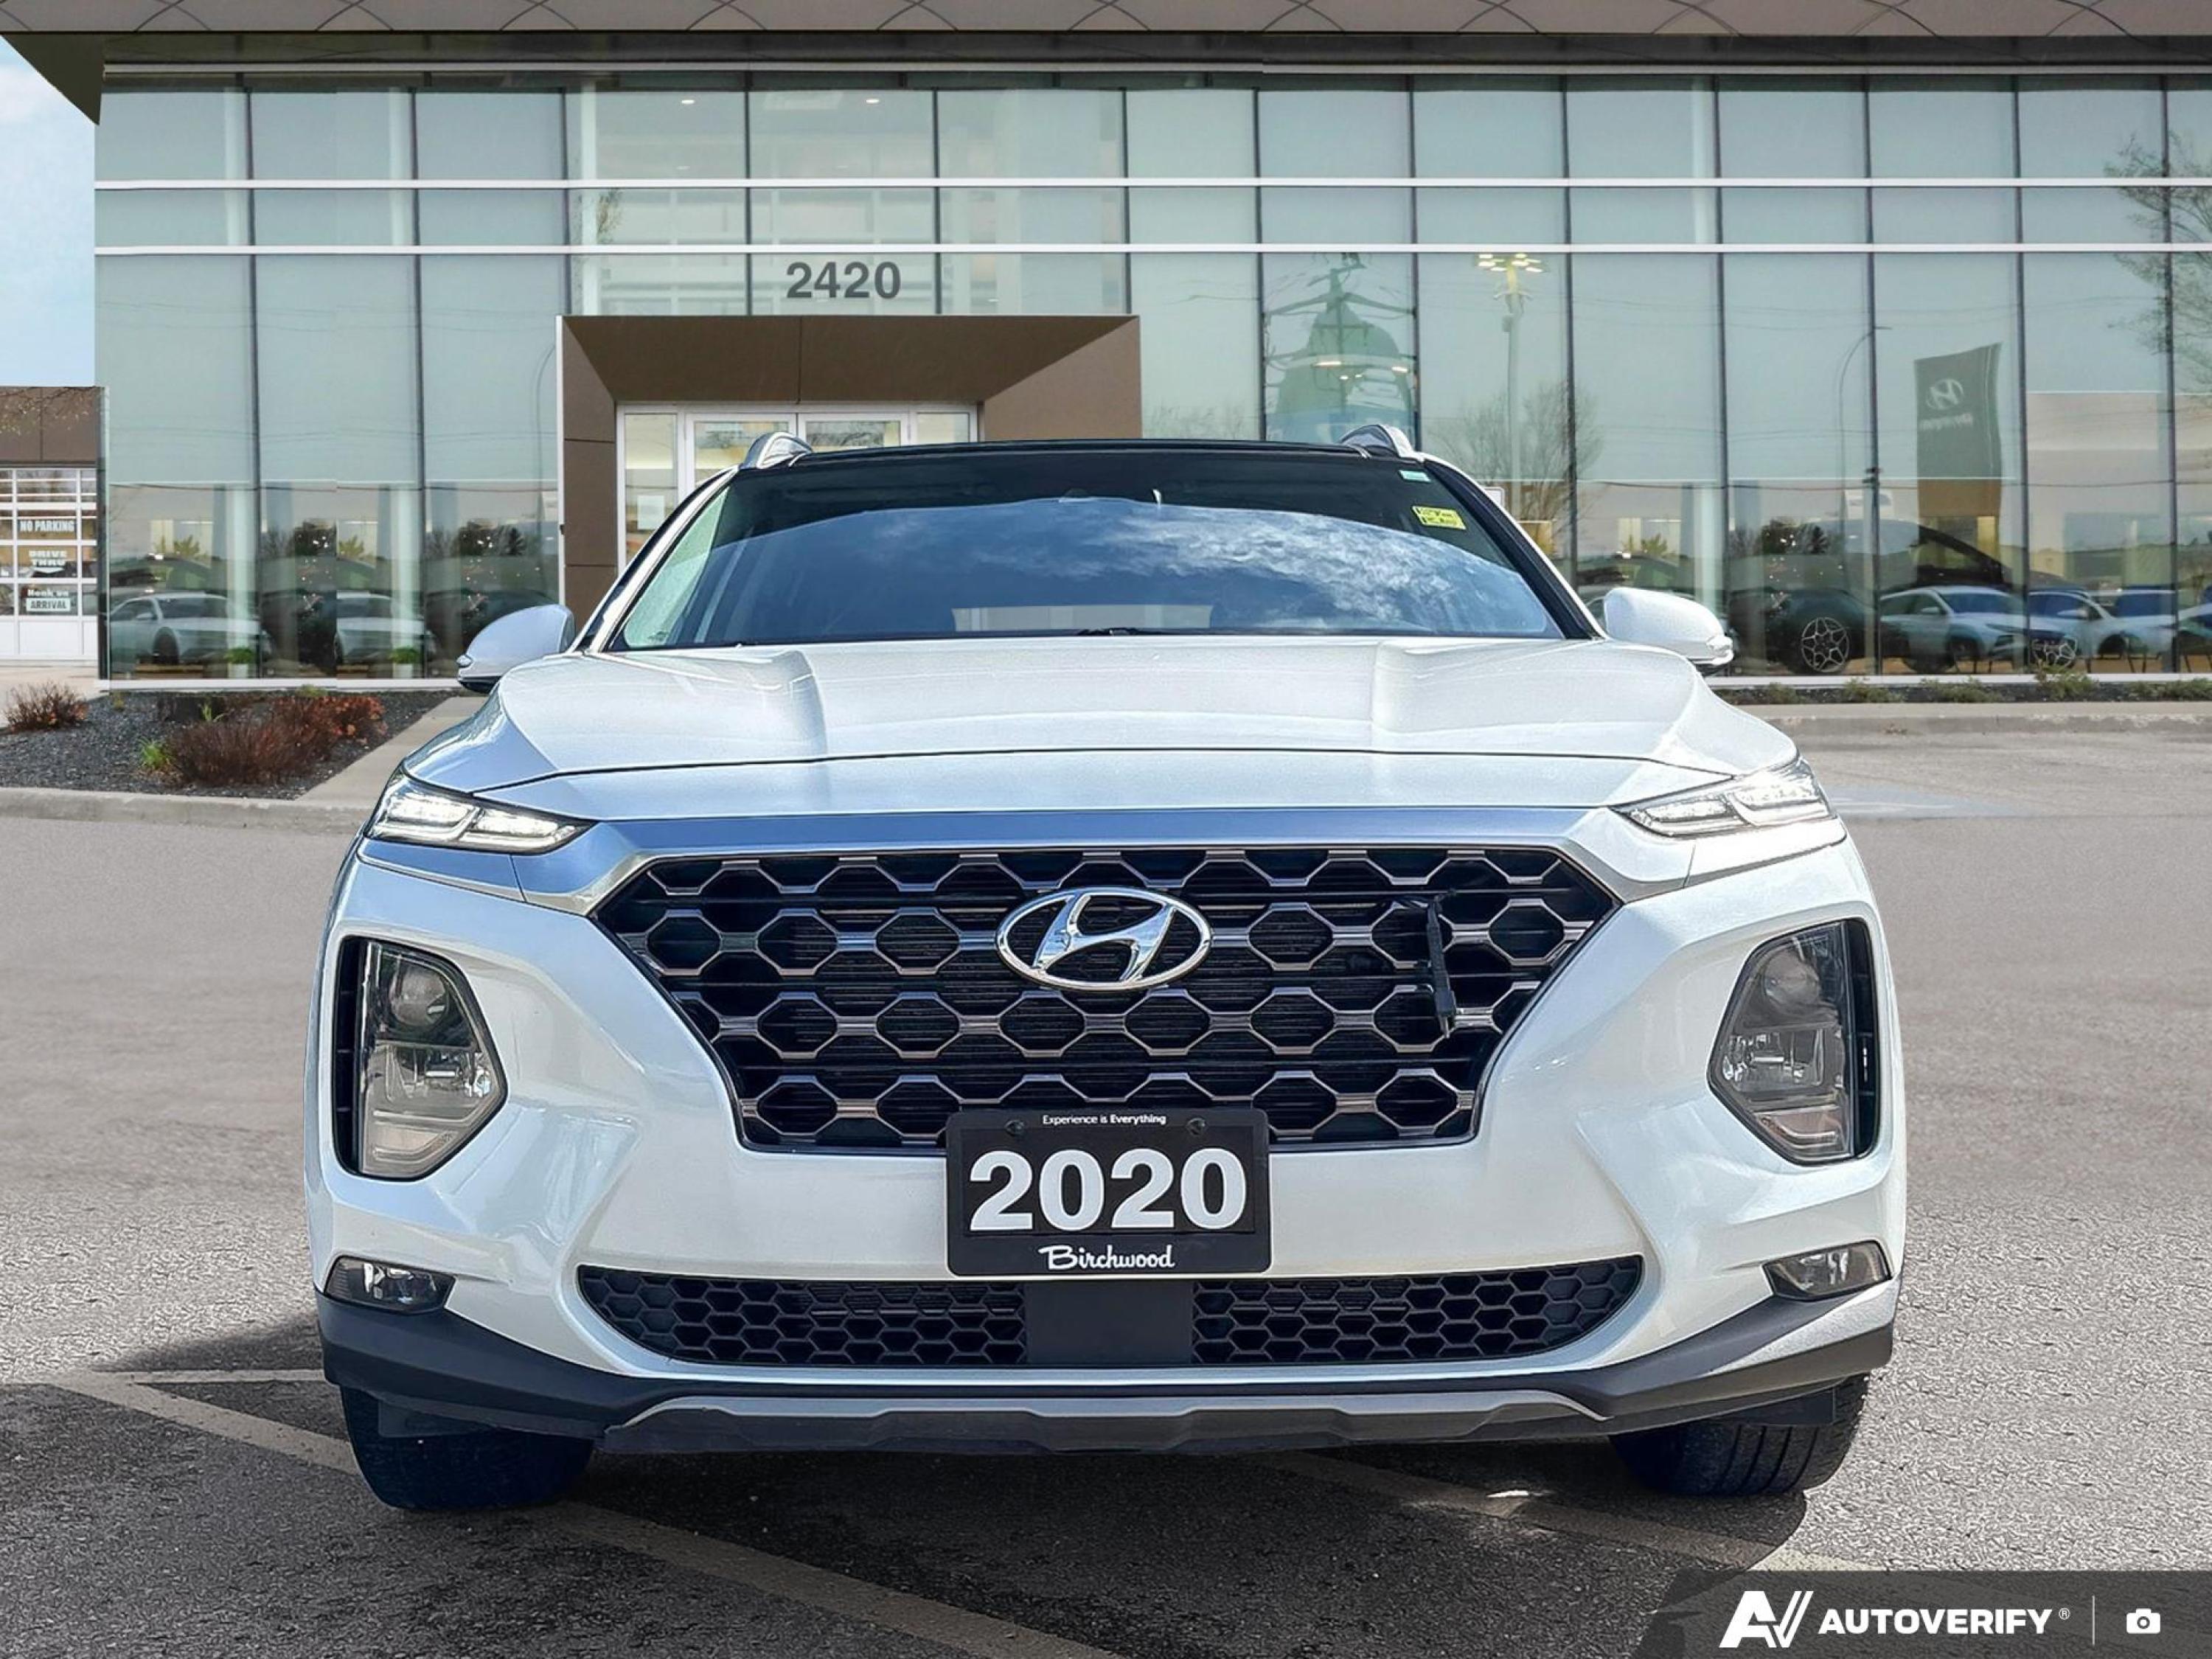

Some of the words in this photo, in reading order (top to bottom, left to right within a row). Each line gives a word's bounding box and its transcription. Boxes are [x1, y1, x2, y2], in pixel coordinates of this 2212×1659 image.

[786, 261, 901, 299] 2420
[20, 520, 33, 532] NO
[34, 520, 74, 532] PARKING
[29, 550, 67, 558] DRIVE
[30, 600, 67, 609] ARRIVAL
[1043, 1115, 1098, 1125] Experience
[1100, 1114, 1107, 1124] is
[1110, 1114, 1166, 1124] Everything
[970, 1148, 1246, 1231] 2020
[1038, 1245, 1175, 1270] Birchwood
